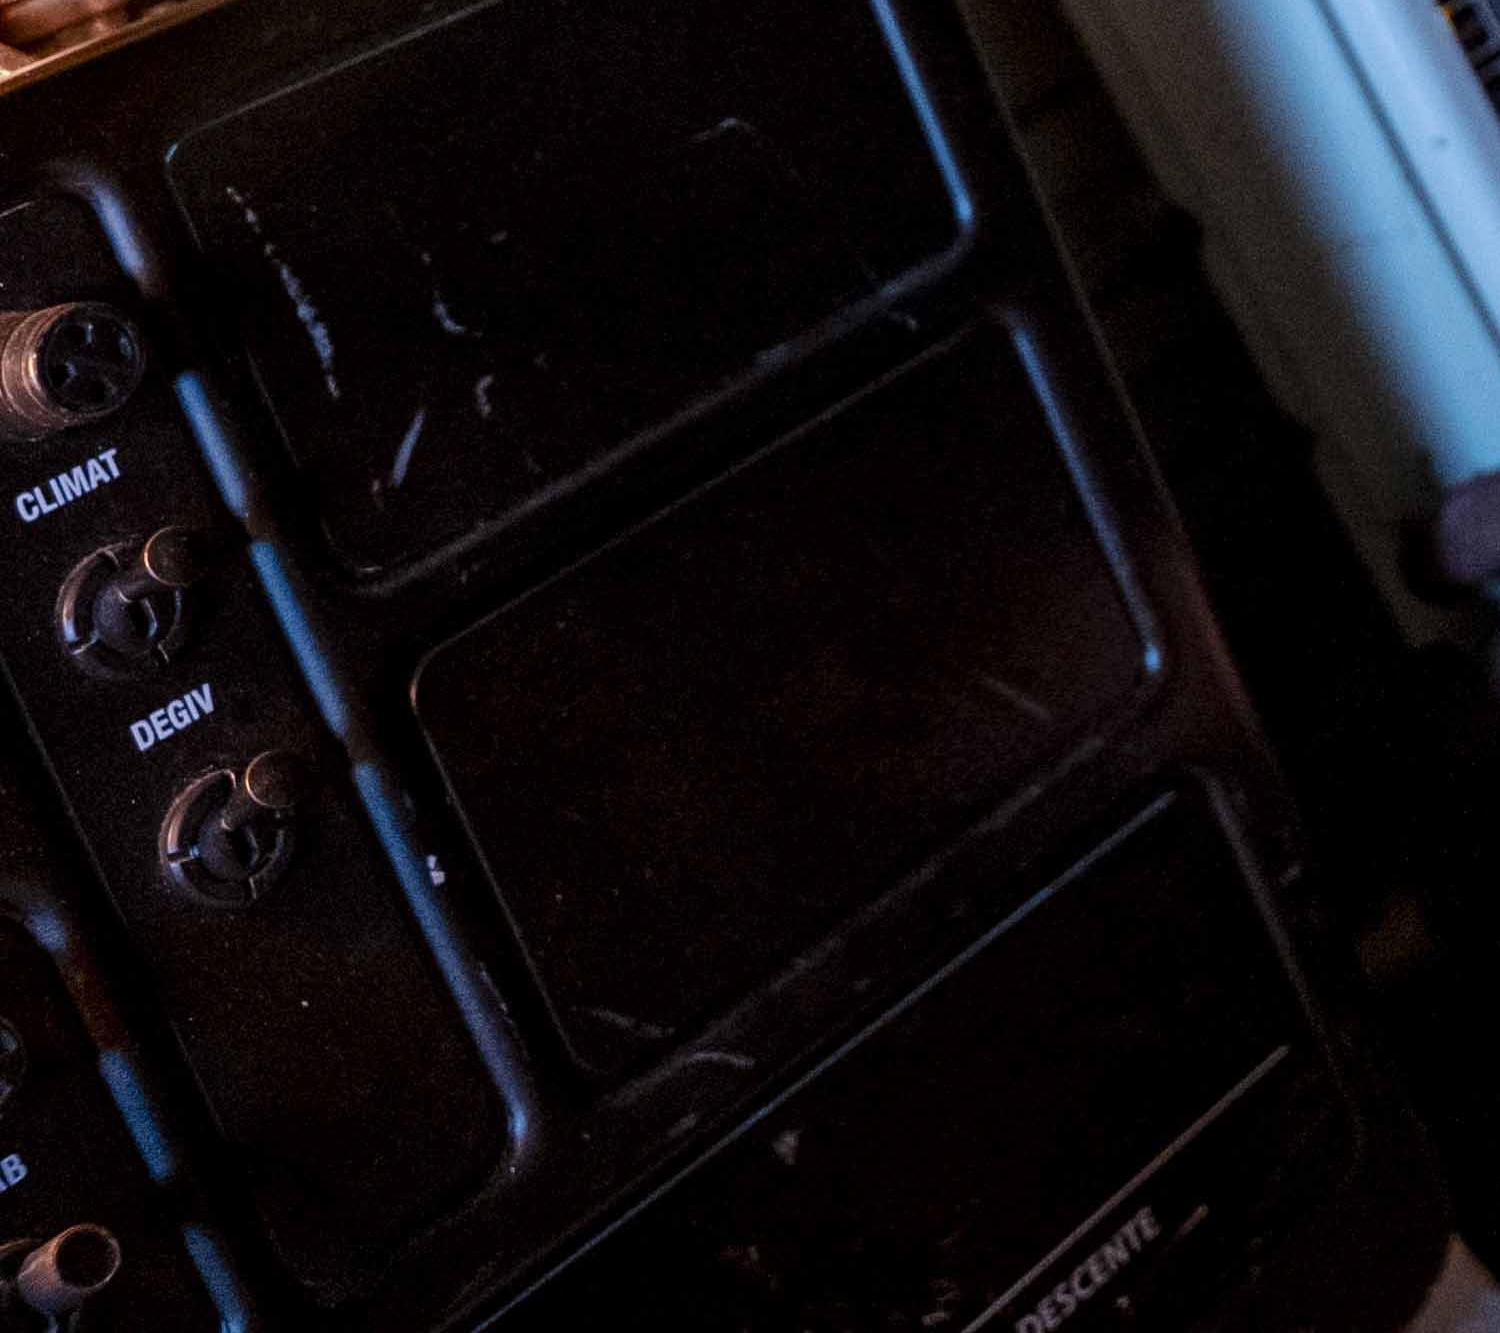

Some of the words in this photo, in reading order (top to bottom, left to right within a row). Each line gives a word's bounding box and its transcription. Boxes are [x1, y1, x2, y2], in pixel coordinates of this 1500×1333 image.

[15, 448, 122, 524] CLIMAT
[129, 683, 216, 752] DEGIV
[1014, 1205, 1161, 1333] DESCENTE
